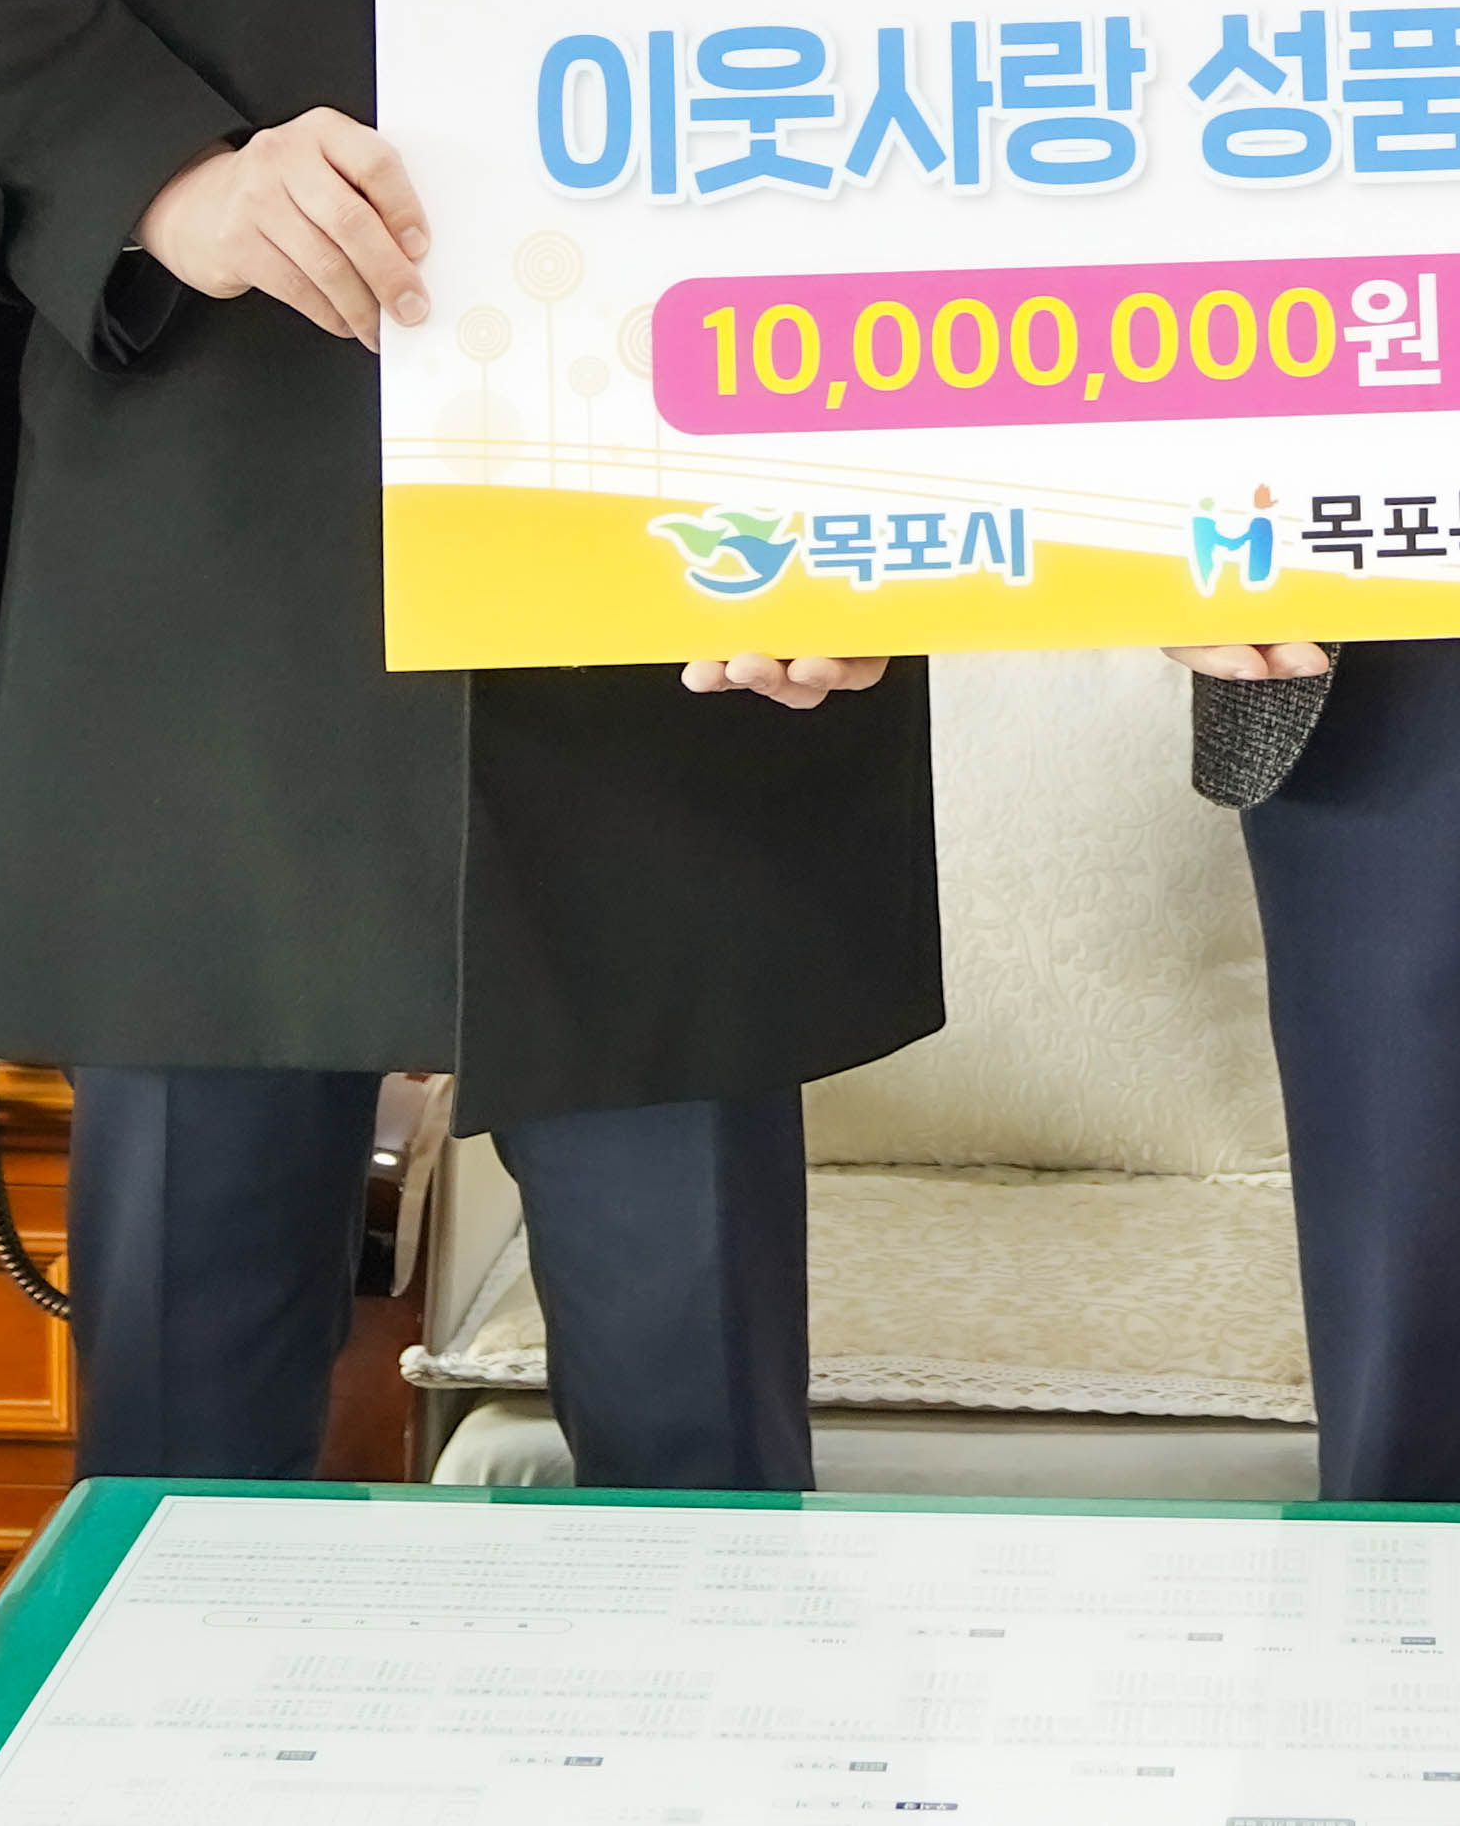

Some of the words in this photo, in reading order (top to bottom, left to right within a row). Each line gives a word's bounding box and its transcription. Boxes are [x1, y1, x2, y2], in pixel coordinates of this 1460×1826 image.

[539, 18, 1145, 193] 이웃사랑
[703, 273, 1442, 408] 10,000,000원
[809, 509, 1025, 581] 목포시
